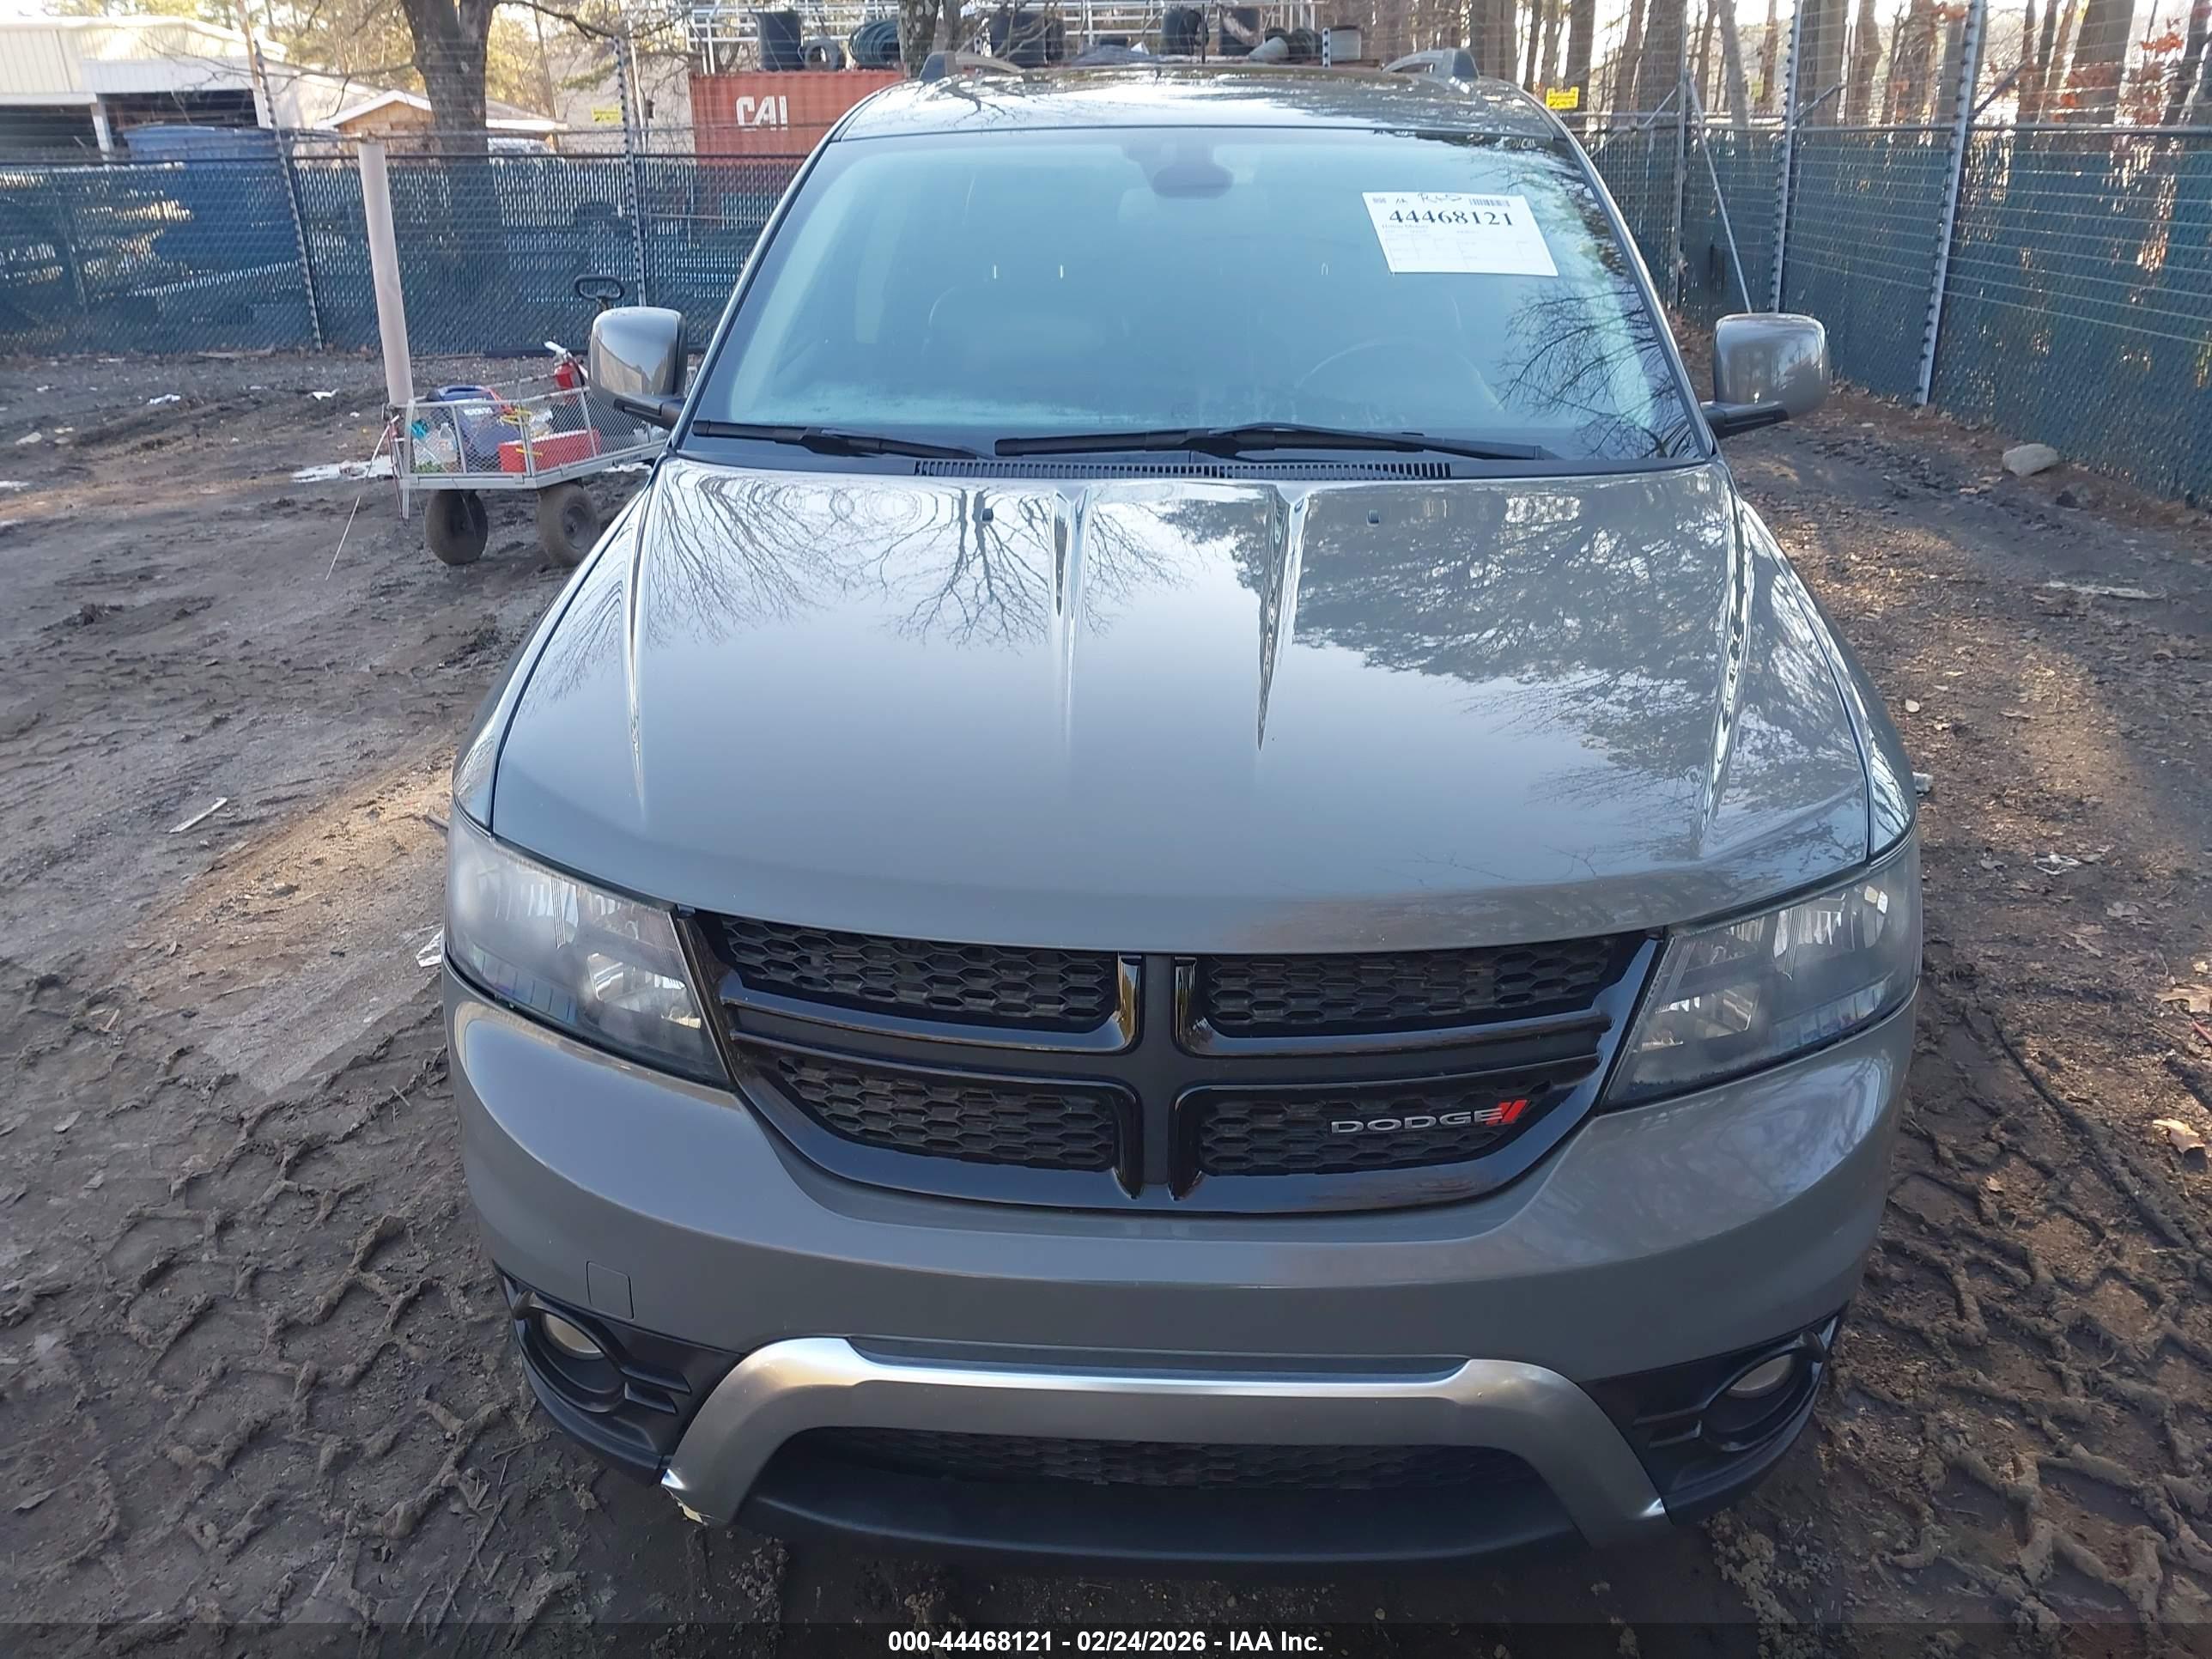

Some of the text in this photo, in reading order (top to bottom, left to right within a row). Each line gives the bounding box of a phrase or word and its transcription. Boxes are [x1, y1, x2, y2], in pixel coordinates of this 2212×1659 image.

[736, 95, 788, 131] CAI
[1389, 210, 1513, 227] 44468121
[1331, 1108, 1503, 1133] DODGE
